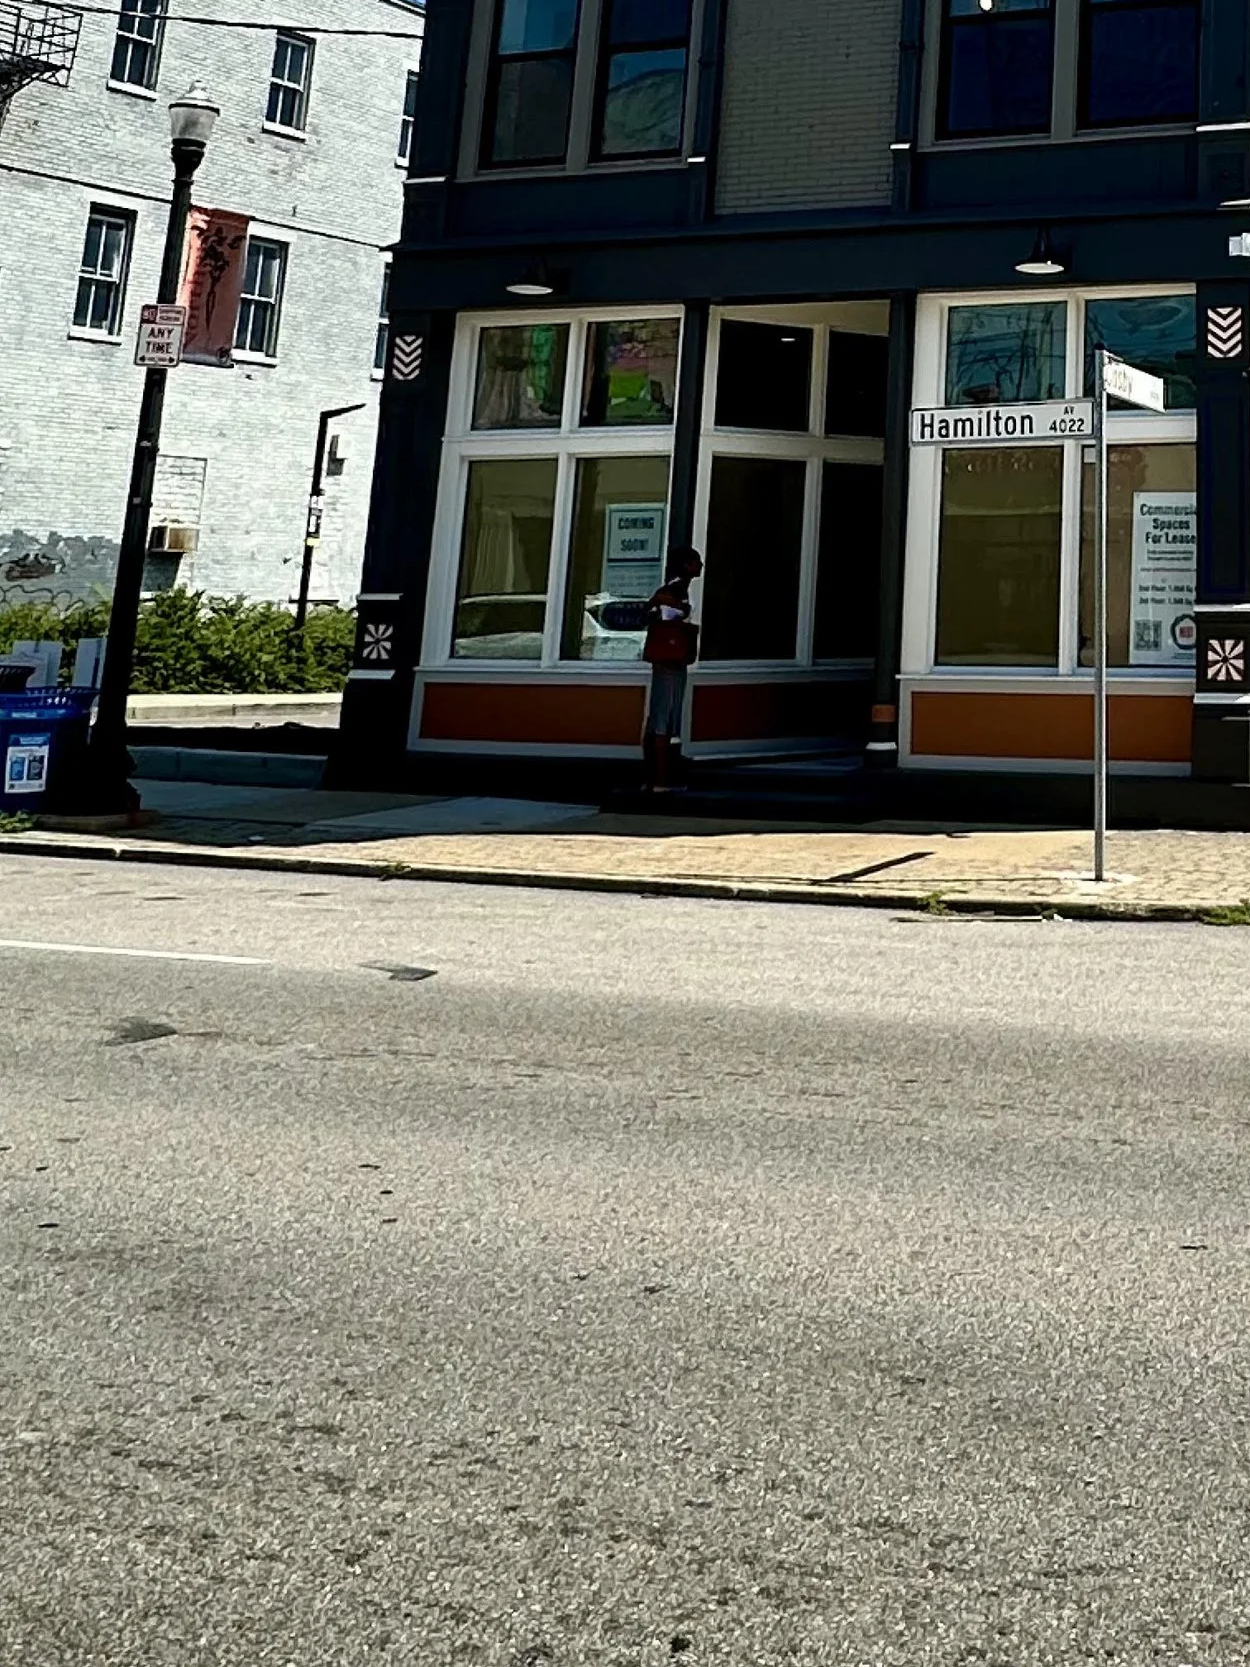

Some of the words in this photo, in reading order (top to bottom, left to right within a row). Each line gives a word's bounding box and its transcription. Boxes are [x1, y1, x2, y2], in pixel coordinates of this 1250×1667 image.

[148, 327, 175, 339] ANY
[145, 341, 173, 354] TIME
[1063, 406, 1075, 415] AV
[919, 409, 1034, 440] Hamilton
[1049, 418, 1085, 433] 4022
[618, 517, 655, 530] COMING
[1152, 518, 1190, 531] Spaces
[1145, 532, 1163, 544] For
[1165, 532, 1196, 544] Lease
